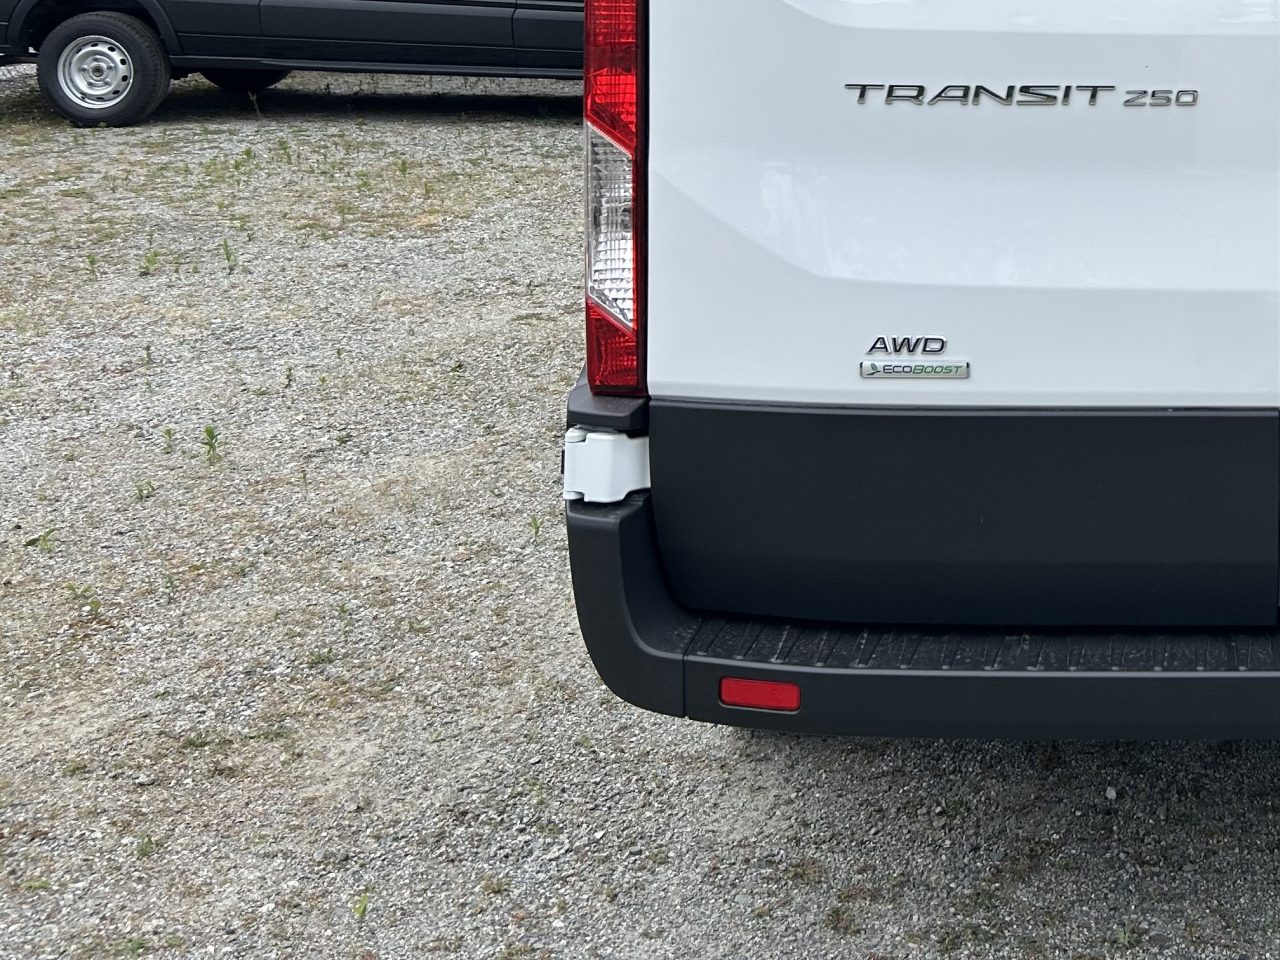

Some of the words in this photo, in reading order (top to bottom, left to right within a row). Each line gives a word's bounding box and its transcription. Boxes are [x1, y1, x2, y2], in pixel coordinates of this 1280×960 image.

[844, 83, 1116, 107] TRANSIT
[1122, 89, 1199, 107] 250
[866, 334, 947, 356] AWD
